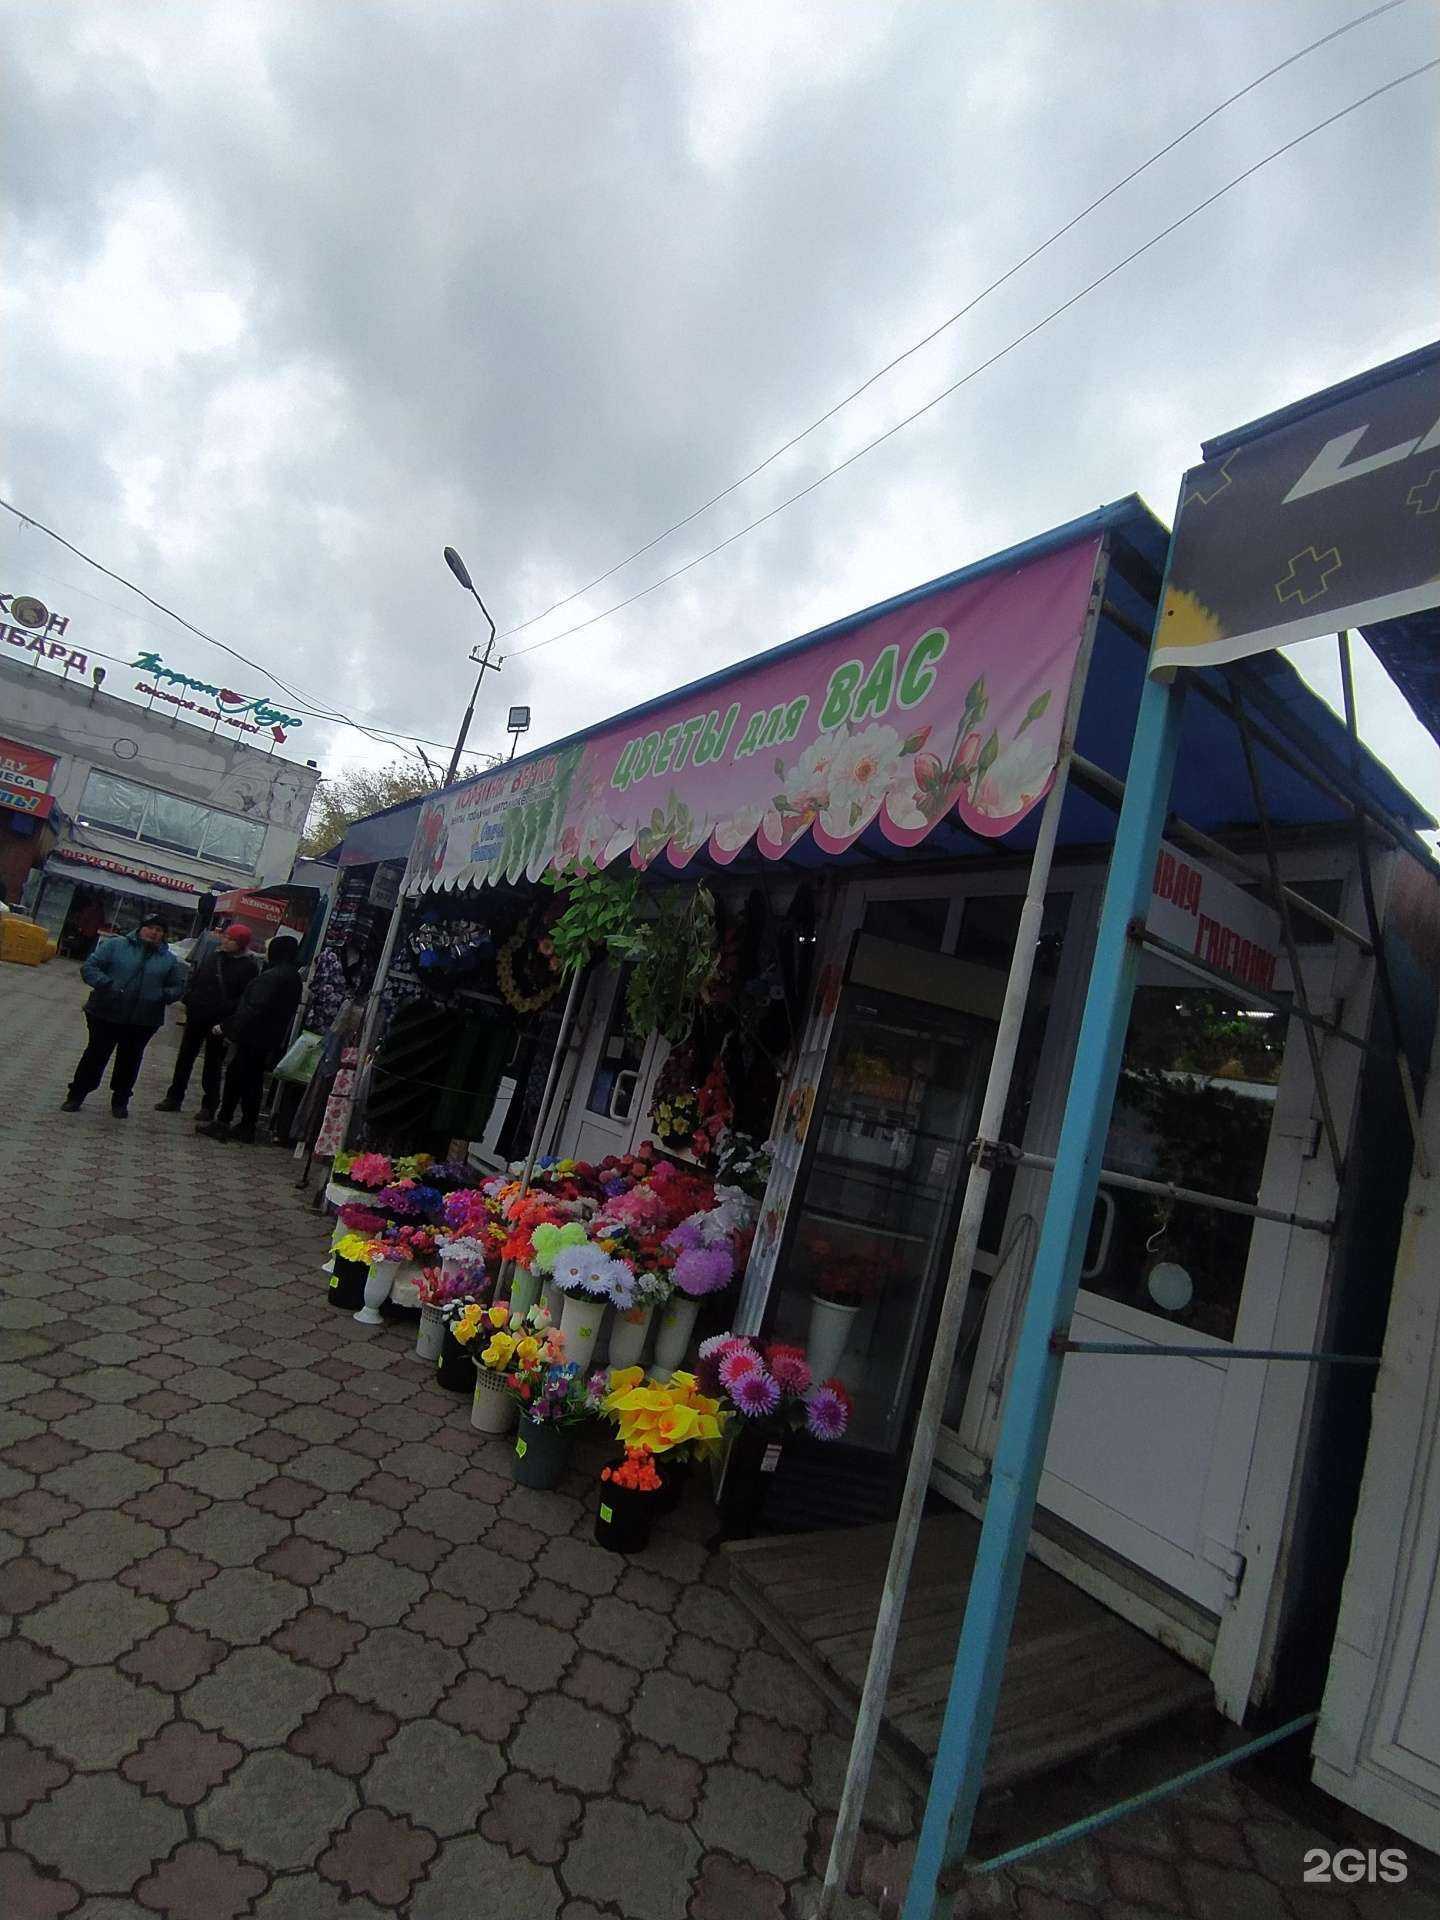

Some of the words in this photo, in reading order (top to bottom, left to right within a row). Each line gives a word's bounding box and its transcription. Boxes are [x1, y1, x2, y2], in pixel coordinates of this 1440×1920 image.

[610, 702, 741, 792] ЦВЕТЫ
[818, 627, 949, 733] ВАС
[139, 869, 196, 891] ОВОЩИ
